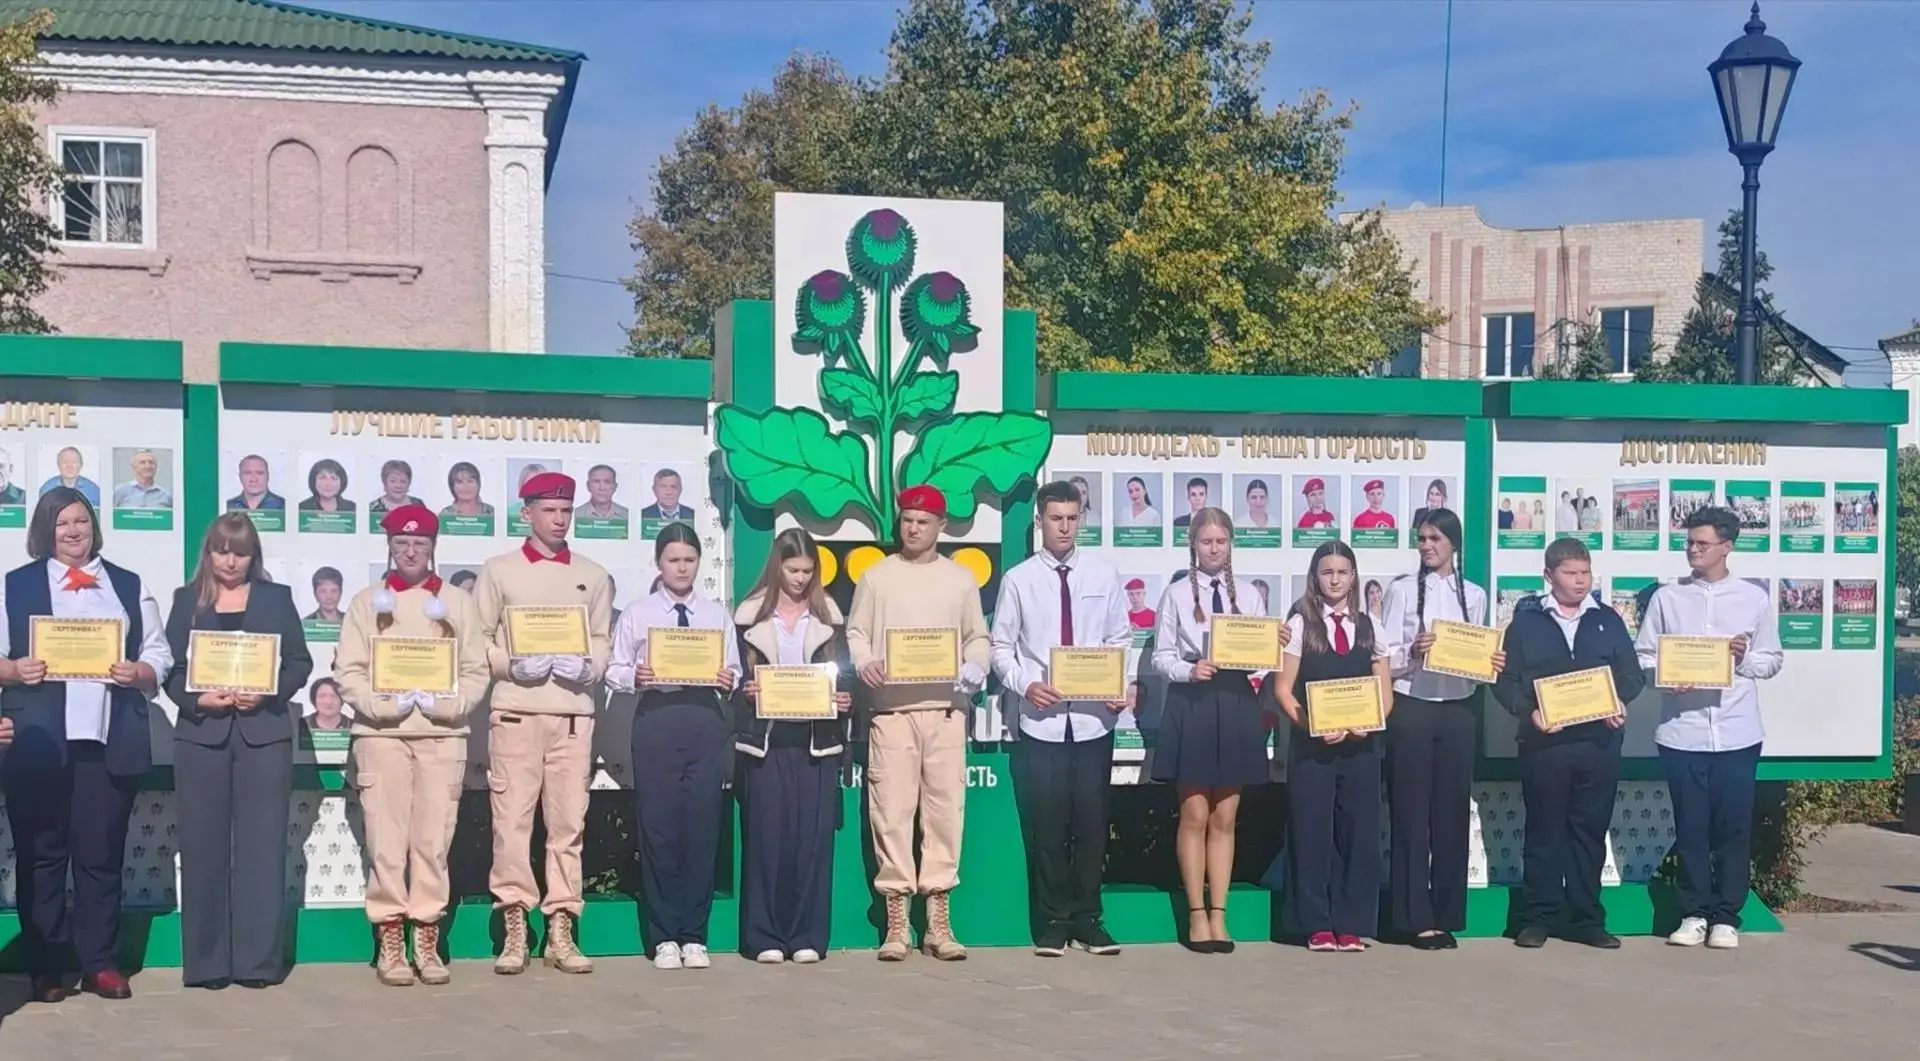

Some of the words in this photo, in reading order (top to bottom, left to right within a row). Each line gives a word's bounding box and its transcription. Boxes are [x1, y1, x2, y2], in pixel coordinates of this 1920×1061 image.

[0, 401, 78, 431] ДАНЕ
[330, 409, 443, 439] ЛУЧШИЕ
[451, 412, 601, 444] РАБОТНИКИ
[1086, 427, 1220, 460] МОЛОДЕЖЬ
[1241, 430, 1307, 459] НАША
[1313, 431, 1426, 463] ГОРДОСТЬ
[1619, 436, 1767, 466] ДОСТИЖЕНИЯ
